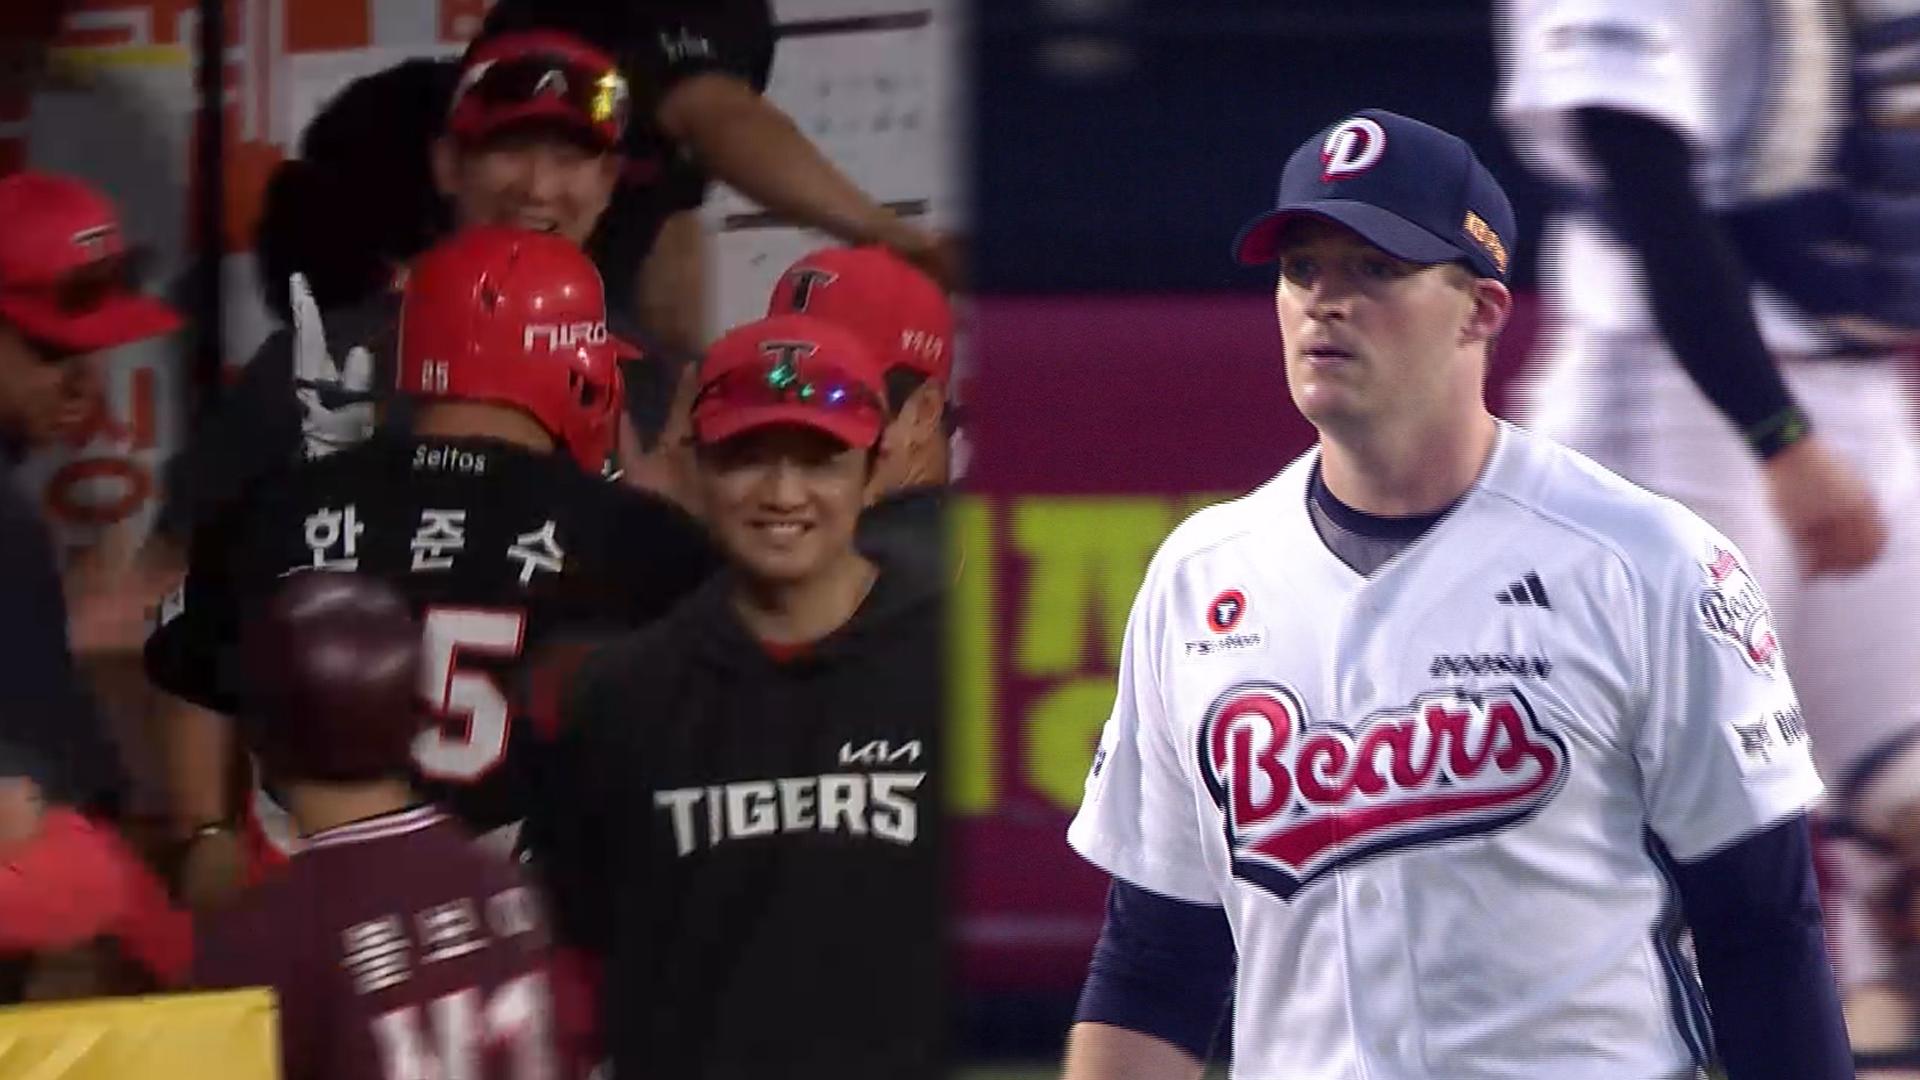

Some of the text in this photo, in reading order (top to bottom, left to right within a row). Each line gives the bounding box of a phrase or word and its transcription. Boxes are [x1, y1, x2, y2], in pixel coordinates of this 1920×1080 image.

[1322, 117, 1387, 182] D
[791, 267, 839, 313] T
[304, 503, 566, 586] 한준수
[838, 739, 921, 766] KIA
[1204, 686, 1562, 832] Bears
[653, 771, 927, 857] TIGERS
